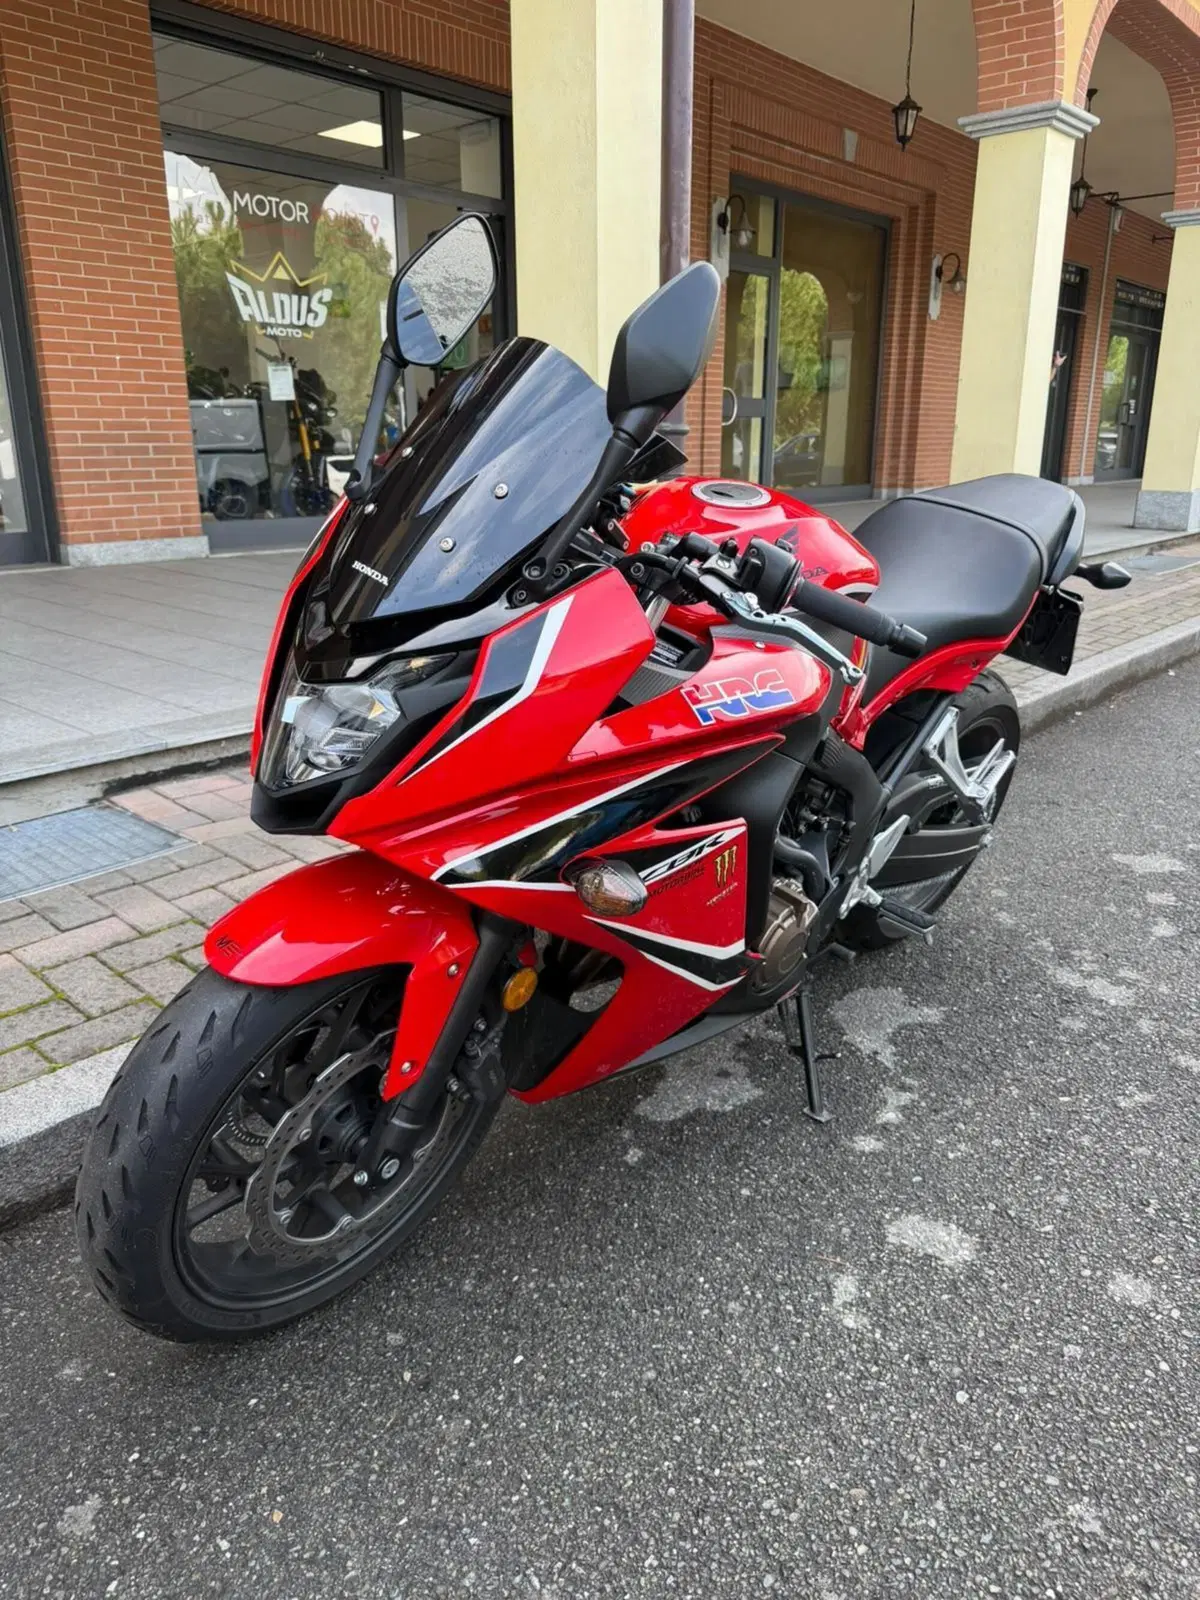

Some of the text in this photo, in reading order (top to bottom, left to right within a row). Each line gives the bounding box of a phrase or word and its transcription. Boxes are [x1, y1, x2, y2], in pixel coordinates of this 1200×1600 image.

[233, 190, 309, 224] MOTOR
[225, 271, 333, 328] ALDUS
[266, 326, 303, 337] MOTO
[351, 560, 389, 586] HONDA
[680, 668, 796, 727] HRC
